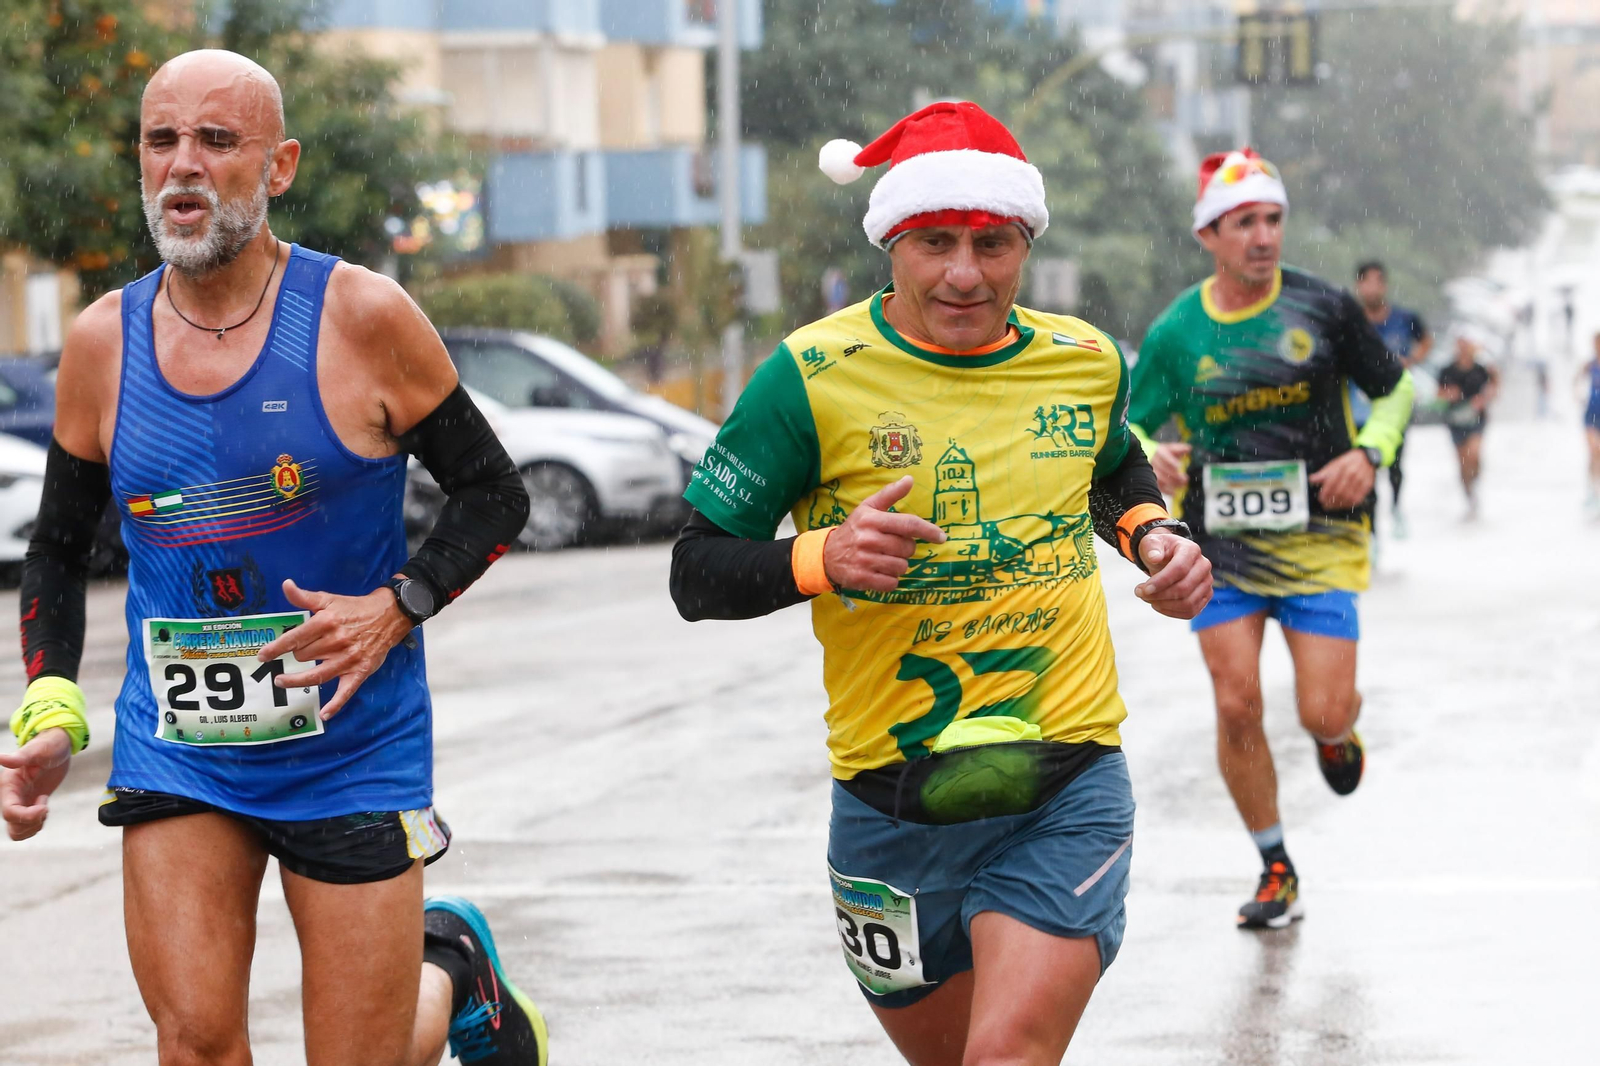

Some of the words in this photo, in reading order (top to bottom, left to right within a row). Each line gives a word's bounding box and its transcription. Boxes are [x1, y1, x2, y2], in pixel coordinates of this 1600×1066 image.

[264, 402, 285, 410] 42K
[1030, 450, 1068, 459] RUNNERS
[703, 477, 738, 509] BARRIOS
[1216, 489, 1291, 517] 309
[174, 632, 221, 650] CARRERA
[225, 628, 276, 650] NAVIDAD
[912, 618, 953, 646] LOS
[962, 607, 1060, 639] BARRIOS
[164, 659, 289, 711] 291
[199, 715, 209, 724] GIL
[214, 714, 228, 724] LUIS
[229, 713, 258, 723] ALBERTO
